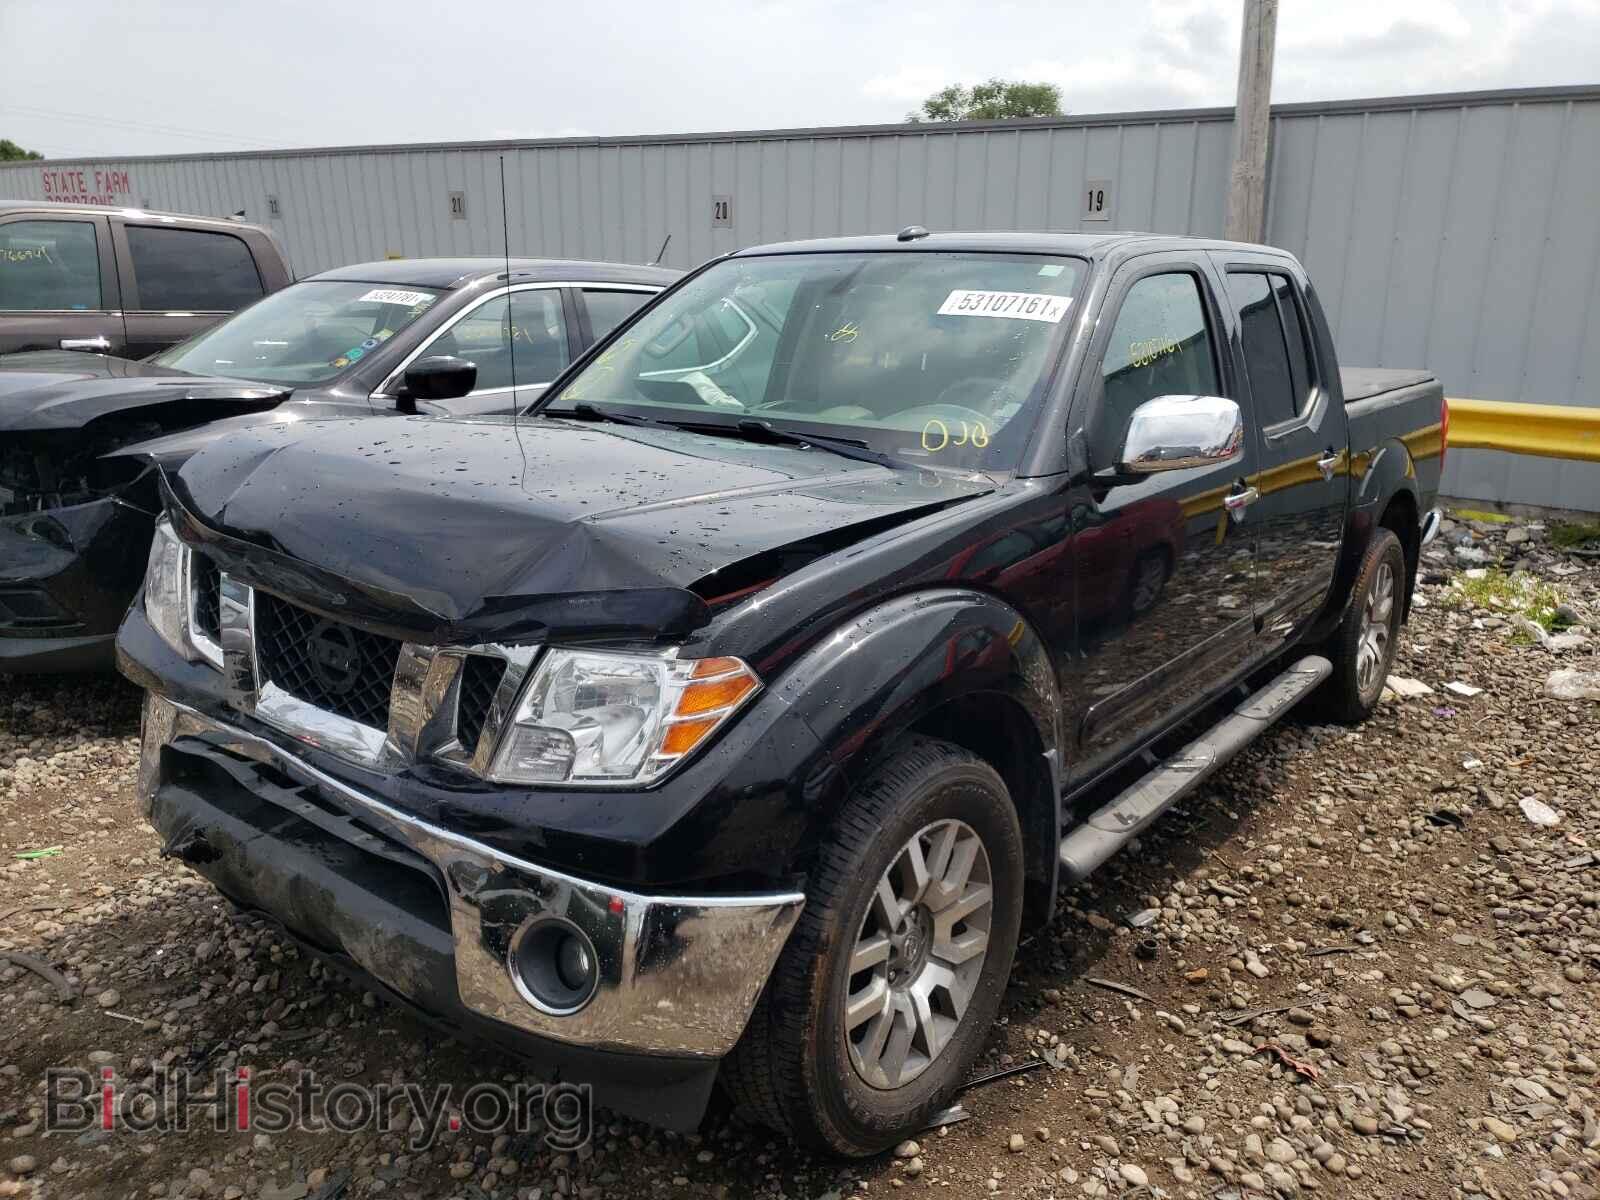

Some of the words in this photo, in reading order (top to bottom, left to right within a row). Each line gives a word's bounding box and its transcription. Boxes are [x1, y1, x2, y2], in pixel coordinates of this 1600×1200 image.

[43, 171, 87, 193] STATE
[95, 171, 130, 194] FARM
[451, 197, 462, 214] 21
[715, 201, 728, 220] 20
[1088, 189, 1104, 212] 19
[958, 293, 1052, 316] 53107161
